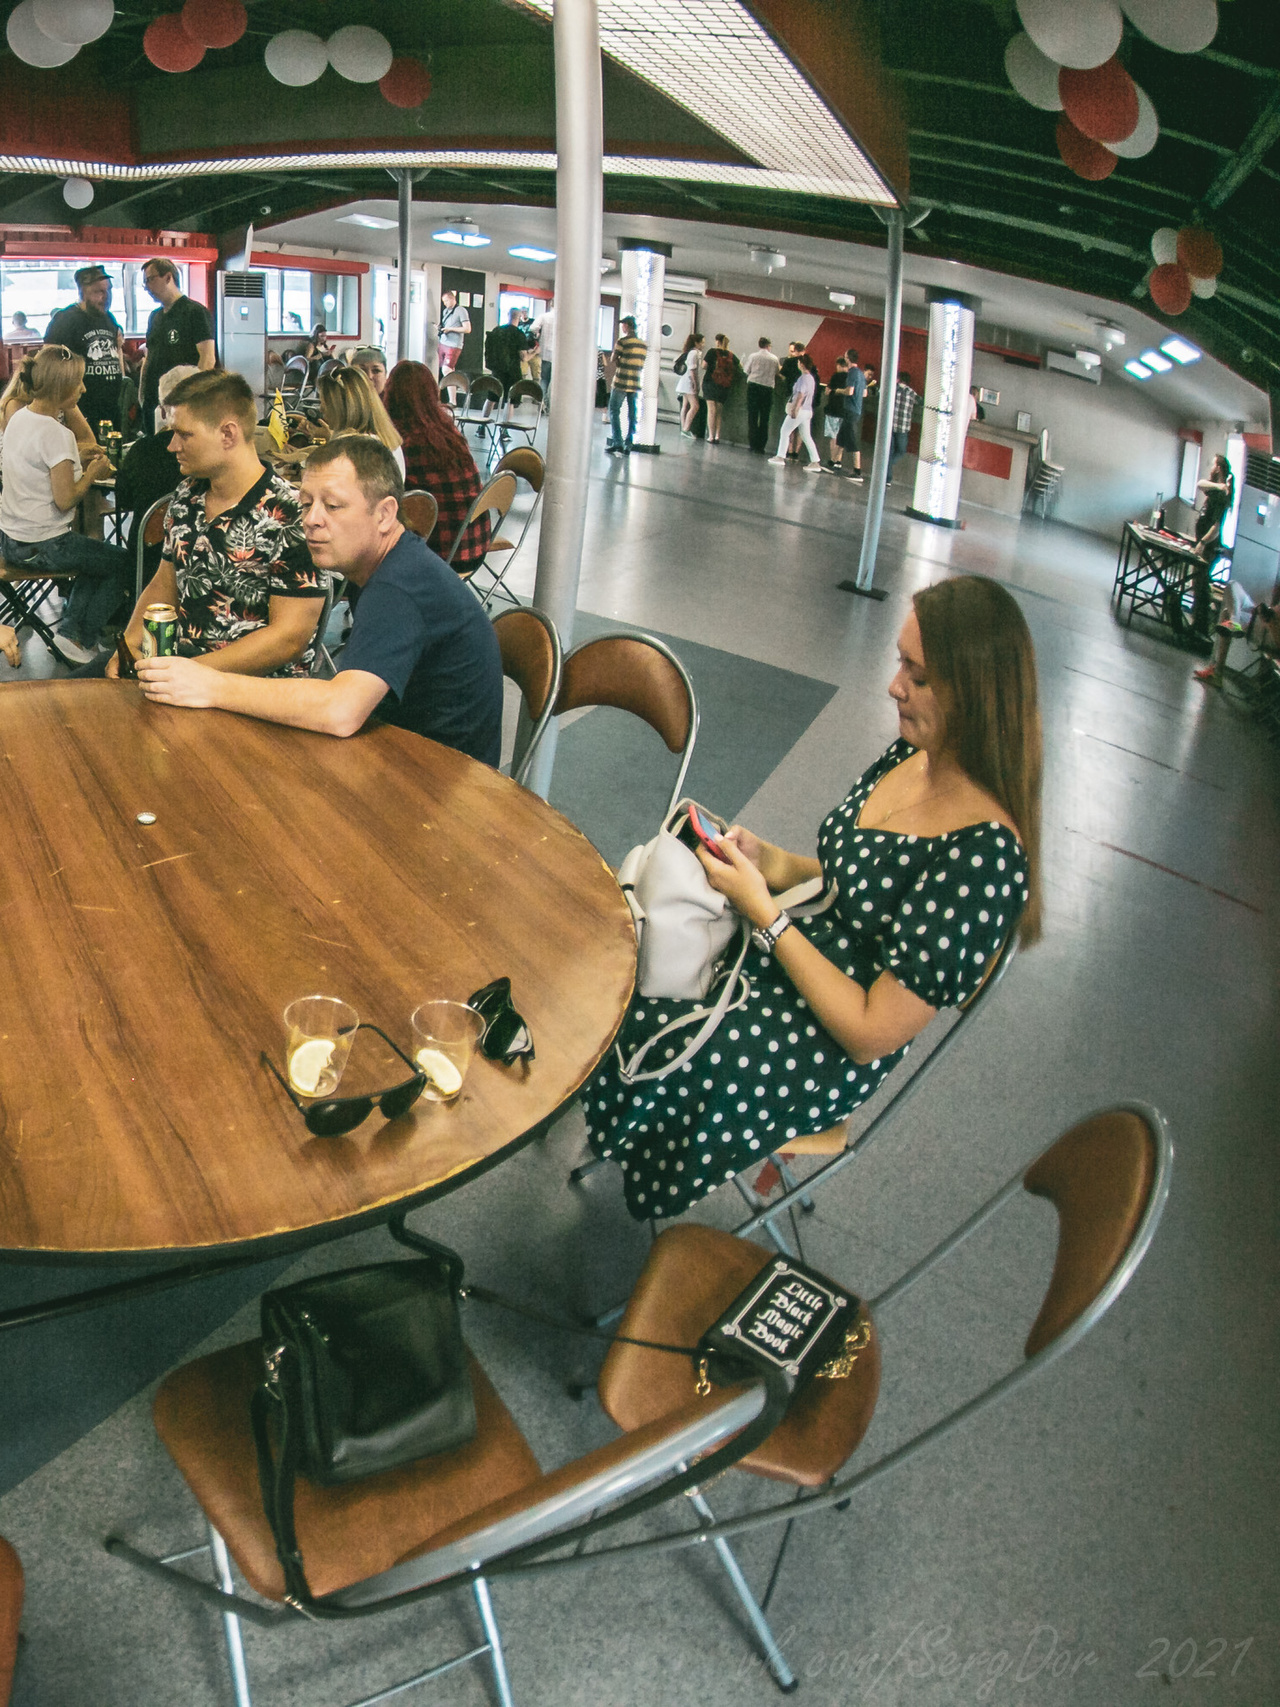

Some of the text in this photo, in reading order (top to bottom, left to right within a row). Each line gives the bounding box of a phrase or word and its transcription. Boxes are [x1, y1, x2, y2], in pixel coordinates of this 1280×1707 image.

[770, 1292, 814, 1326] Black
[782, 1282, 823, 1311] Little
[748, 1321, 791, 1354] Book
[756, 1309, 804, 1339] Magic
